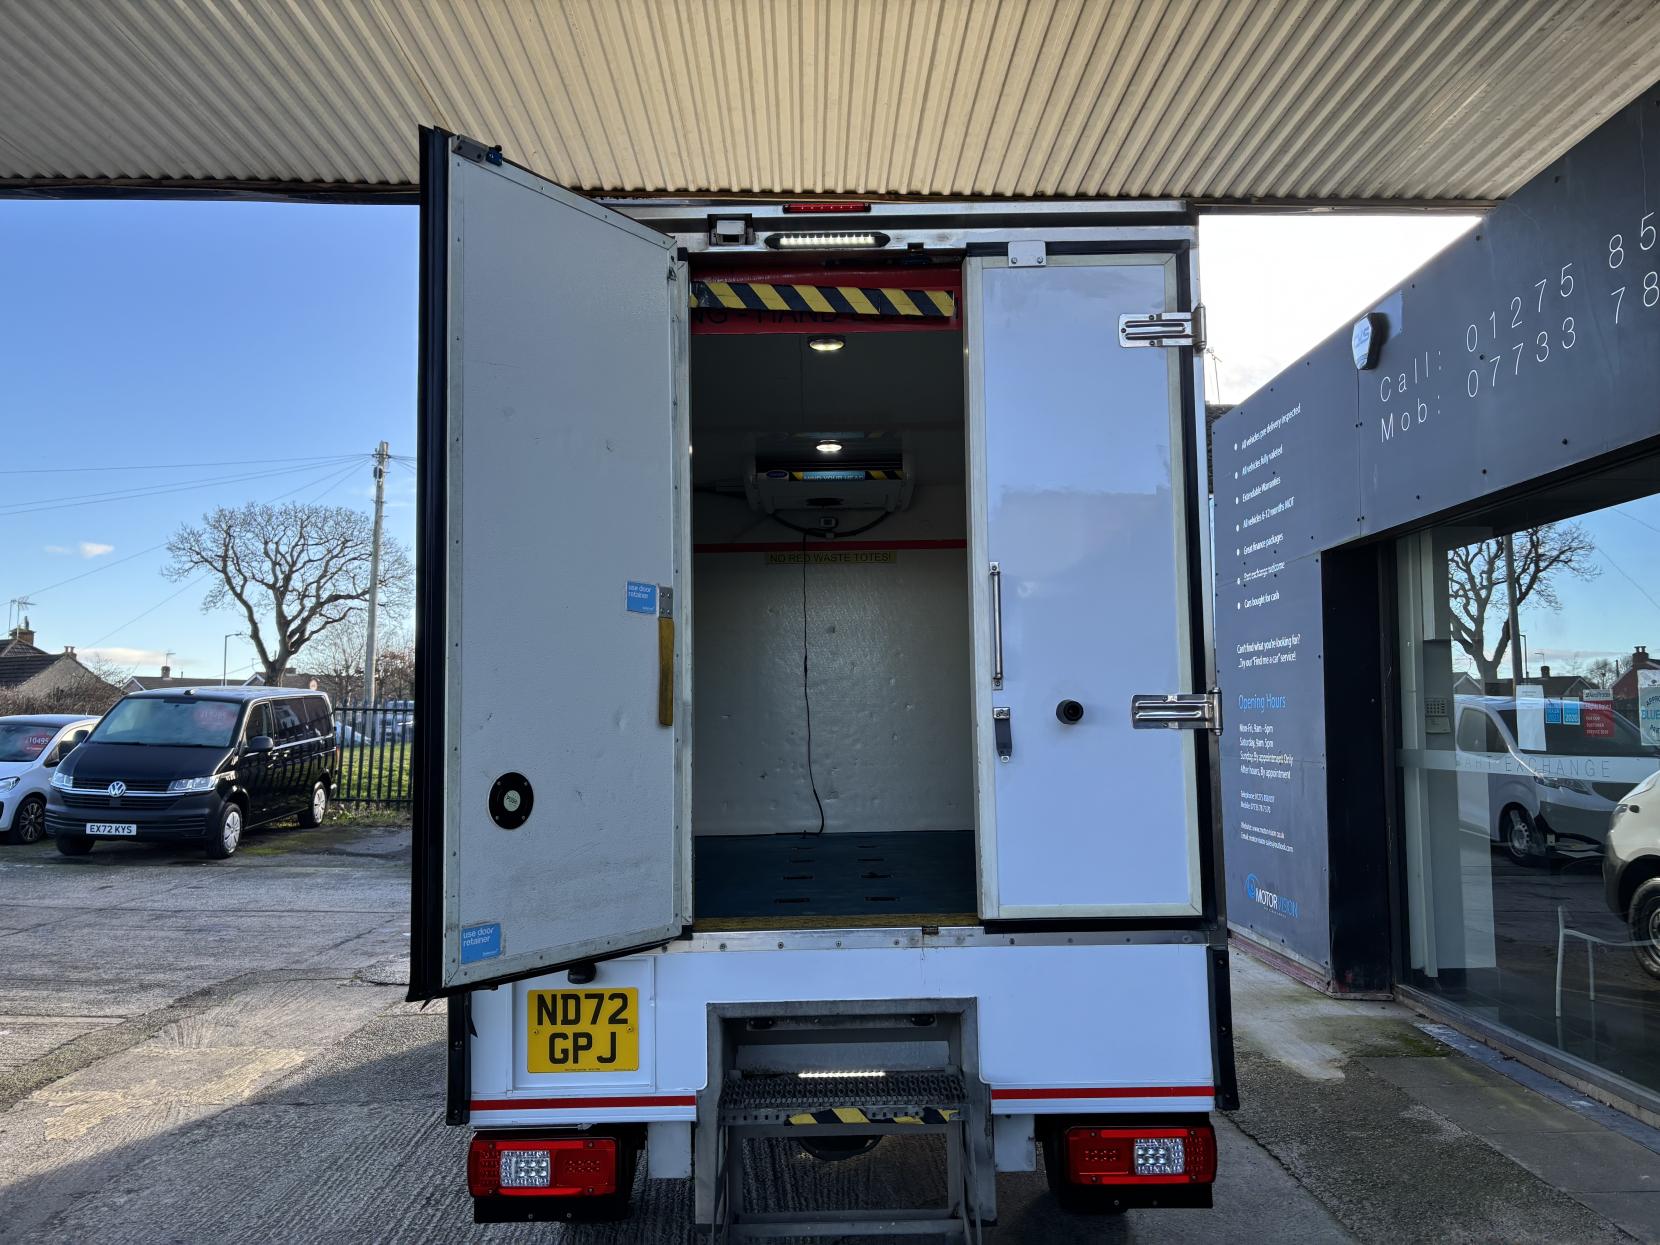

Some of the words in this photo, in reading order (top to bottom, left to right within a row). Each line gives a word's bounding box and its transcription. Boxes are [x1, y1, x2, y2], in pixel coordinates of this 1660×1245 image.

[1380, 350, 1441, 402] Call:
[1466, 263, 1574, 352] 01275
[1381, 395, 1440, 443] Mob:
[1467, 317, 1576, 398] 07733
[770, 554, 786, 563] NO
[789, 553, 811, 562] RED
[814, 553, 850, 562] WASTE
[1238, 694, 1265, 713] Opening
[1265, 693, 1286, 708] Hours
[1505, 756, 1612, 778] EXCHANGE
[89, 824, 113, 834] EX72
[114, 825, 132, 834] KYS
[463, 929, 476, 939] use
[477, 926, 495, 936] door
[463, 936, 490, 947] retainer
[537, 992, 629, 1026] ND72
[549, 1031, 617, 1065] GPJ
